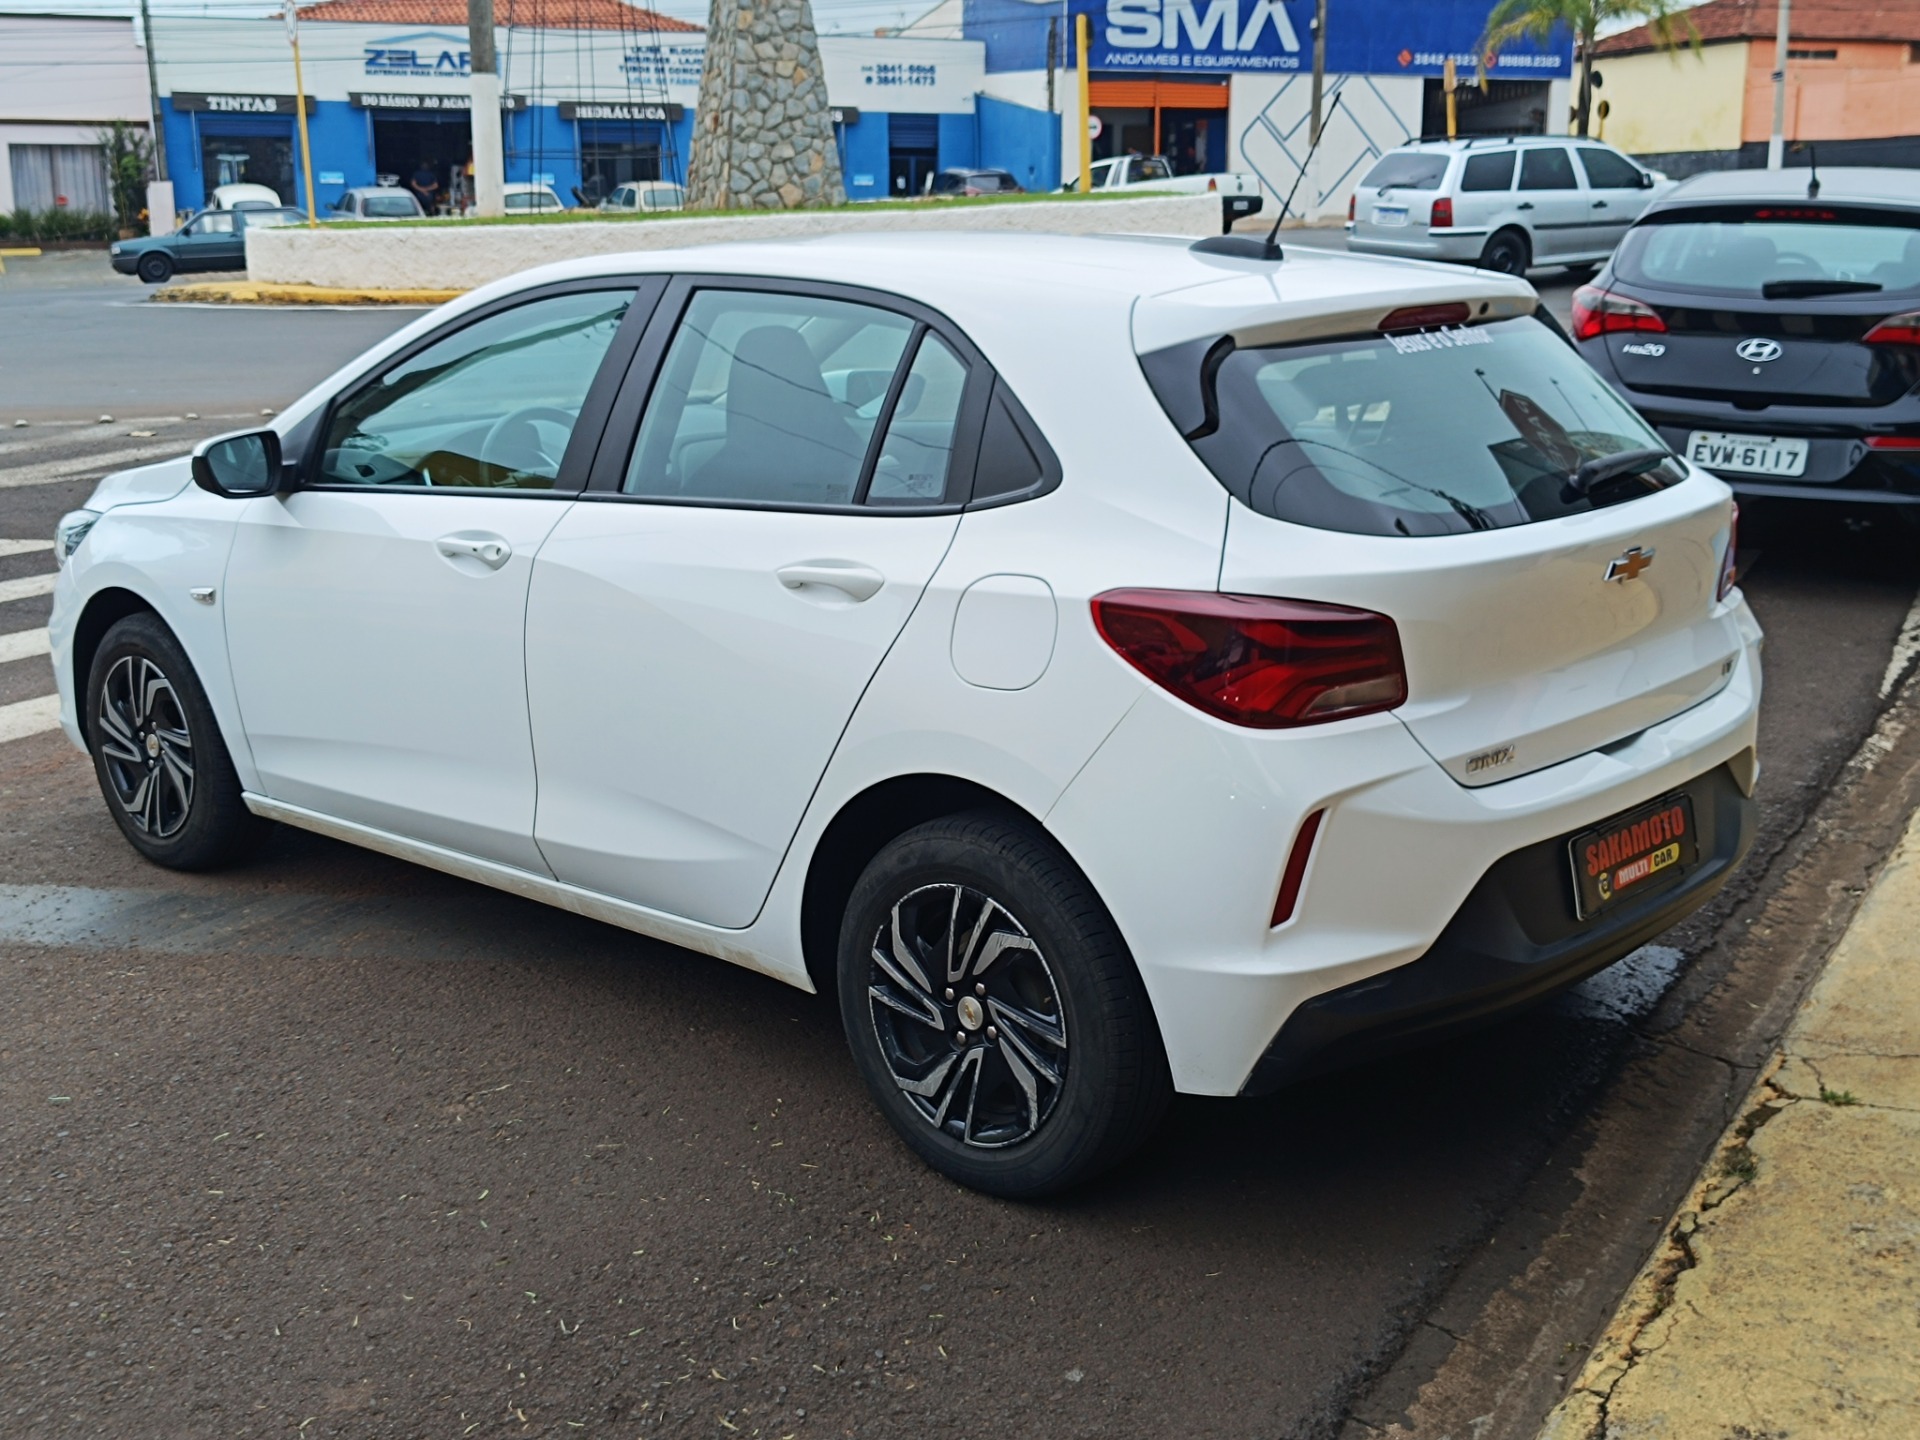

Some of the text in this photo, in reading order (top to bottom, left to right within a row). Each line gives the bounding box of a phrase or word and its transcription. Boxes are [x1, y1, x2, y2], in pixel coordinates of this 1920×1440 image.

[1105, 0, 1300, 52] SMA
[1105, 53, 1299, 68] ANDAIMES E EQUIPAMENTOS
[668, 67, 702, 75] CONCR
[206, 95, 277, 112] TINTAS
[575, 104, 666, 120] HIDRÁULICA
[1585, 806, 1684, 876] SAKAMOTO
[1617, 848, 1673, 885] MULTI CAR
